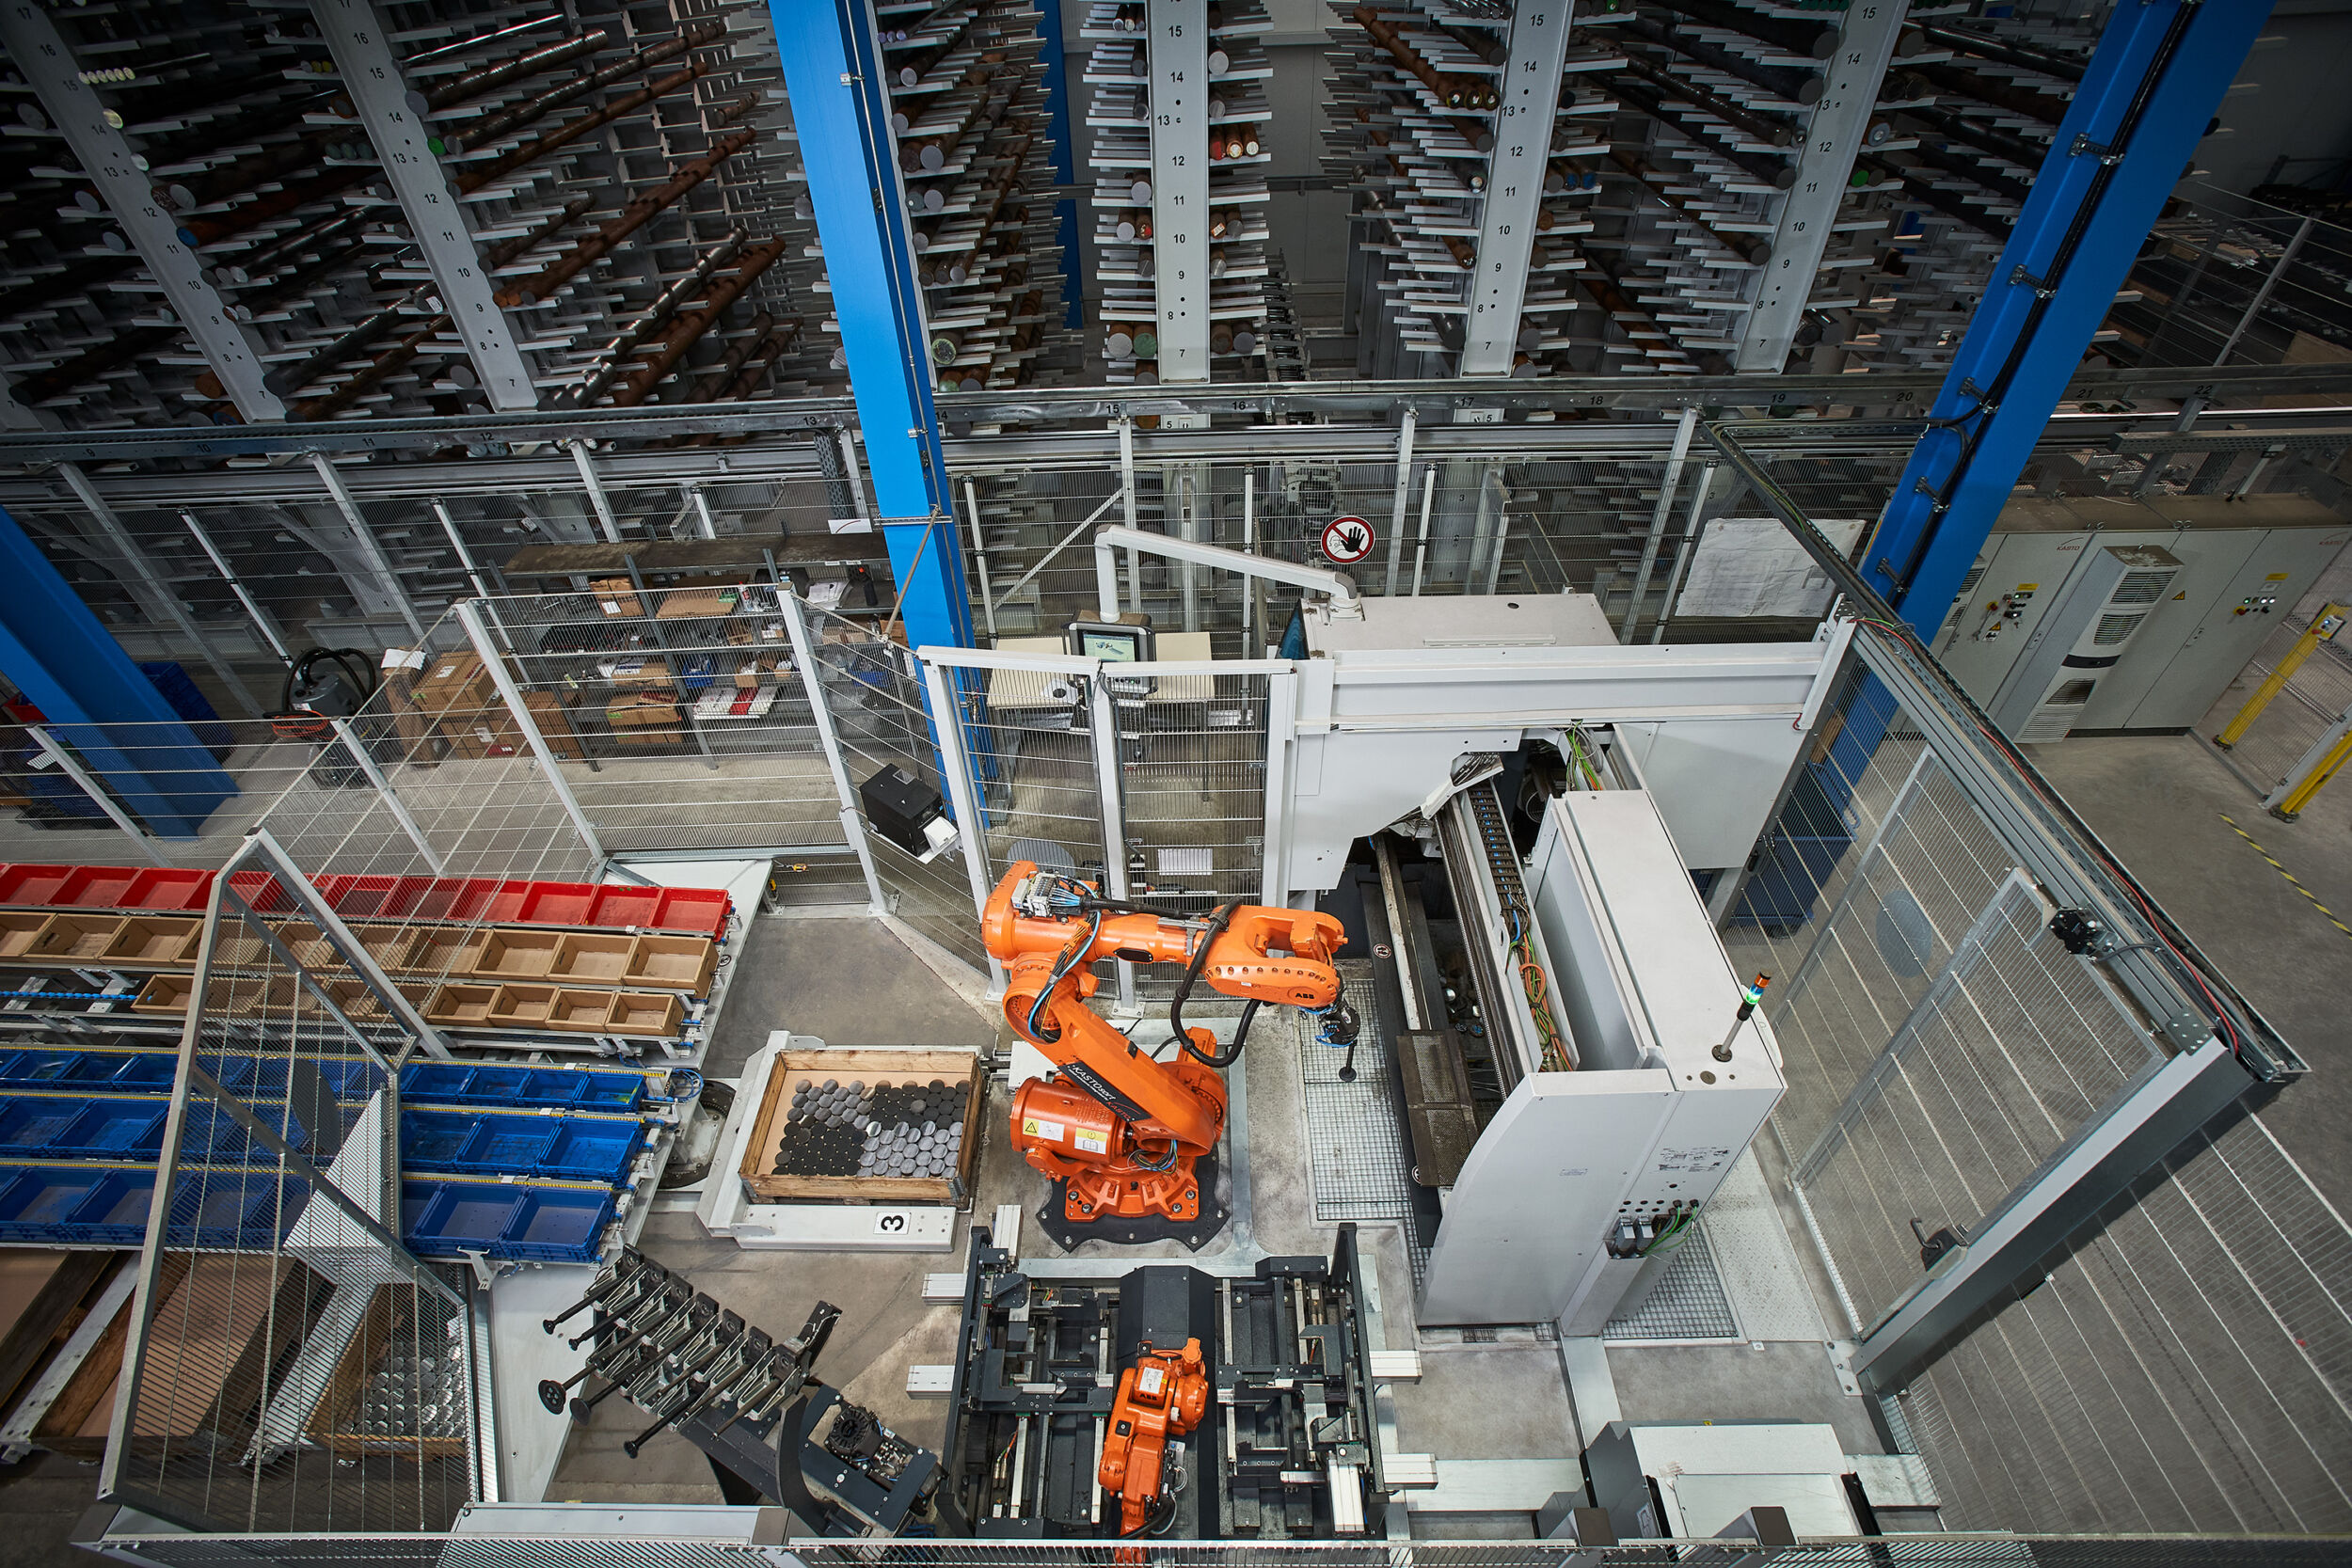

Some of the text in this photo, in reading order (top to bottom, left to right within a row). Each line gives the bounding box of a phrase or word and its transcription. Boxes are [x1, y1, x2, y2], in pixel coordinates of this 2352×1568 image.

[16, 7, 32, 20] 17
[1862, 7, 1877, 20] 15
[1530, 14, 1545, 26] 15
[1168, 24, 1183, 38] 15
[353, 32, 369, 45] 16
[40, 43, 56, 56] 16
[1847, 53, 1861, 65] 14
[1523, 60, 1537, 72] 14
[370, 67, 385, 79] 15
[1170, 71, 1184, 83] 14
[62, 79, 79, 91] 15
[1817, 99, 1831, 110] 13
[1502, 105, 1516, 117] 13
[389, 112, 404, 123] 14
[1157, 114, 1170, 126] 13
[91, 124, 107, 135] 14
[1510, 146, 1523, 157] 12
[1819, 141, 1833, 152] 12
[392, 152, 407, 164] 13
[1171, 155, 1184, 166] 12
[103, 166, 119, 178] 13
[1504, 186, 1517, 197] 11
[1806, 182, 1819, 193] 11
[424, 193, 438, 204] 12
[1173, 195, 1184, 205] 11
[142, 207, 158, 217] 12
[1499, 225, 1511, 235] 10
[1792, 221, 1805, 232] 10
[442, 230, 455, 242] 11
[1173, 233, 1186, 244] 10
[167, 244, 180, 254] 11
[1495, 262, 1502, 273] 9
[1783, 259, 1790, 269] 9
[457, 267, 470, 277] 10
[1178, 270, 1185, 280] 9
[187, 280, 201, 291] 10
[475, 303, 484, 312] 9
[1477, 304, 1484, 313] 8
[1756, 300, 1765, 309] 8
[211, 315, 219, 325] 9
[1168, 310, 1174, 321] 8
[480, 341, 487, 351] 8
[1485, 341, 1492, 351] 7
[1758, 339, 1767, 349] 7
[222, 353, 231, 363] 8
[1179, 348, 1185, 358] 7
[508, 378, 516, 388] 7
[258, 390, 266, 400] 7
[2075, 388, 2093, 399] 21
[2194, 384, 2214, 395] 22
[1460, 397, 1475, 406] 17
[1589, 395, 1604, 405] 18
[1772, 392, 1787, 404] 19
[1896, 391, 1914, 403] 20
[7, 400, 15, 408] 7
[1105, 404, 1120, 415] 15
[1232, 400, 1246, 410] 16
[934, 410, 948, 420] 14
[1486, 414, 1493, 422] 5
[803, 416, 818, 426] 13
[1167, 420, 1173, 429] 5
[362, 437, 375, 447] 11
[480, 431, 495, 442] 12
[197, 443, 212, 453] 10
[1459, 494, 1466, 502] 3
[1708, 491, 1716, 500] 3
[1072, 1066, 1117, 1101] KASTOsort
[1105, 1101, 1132, 1121] KASTO
[881, 1214, 904, 1230] 3
[1139, 1392, 1157, 1401] ABB
